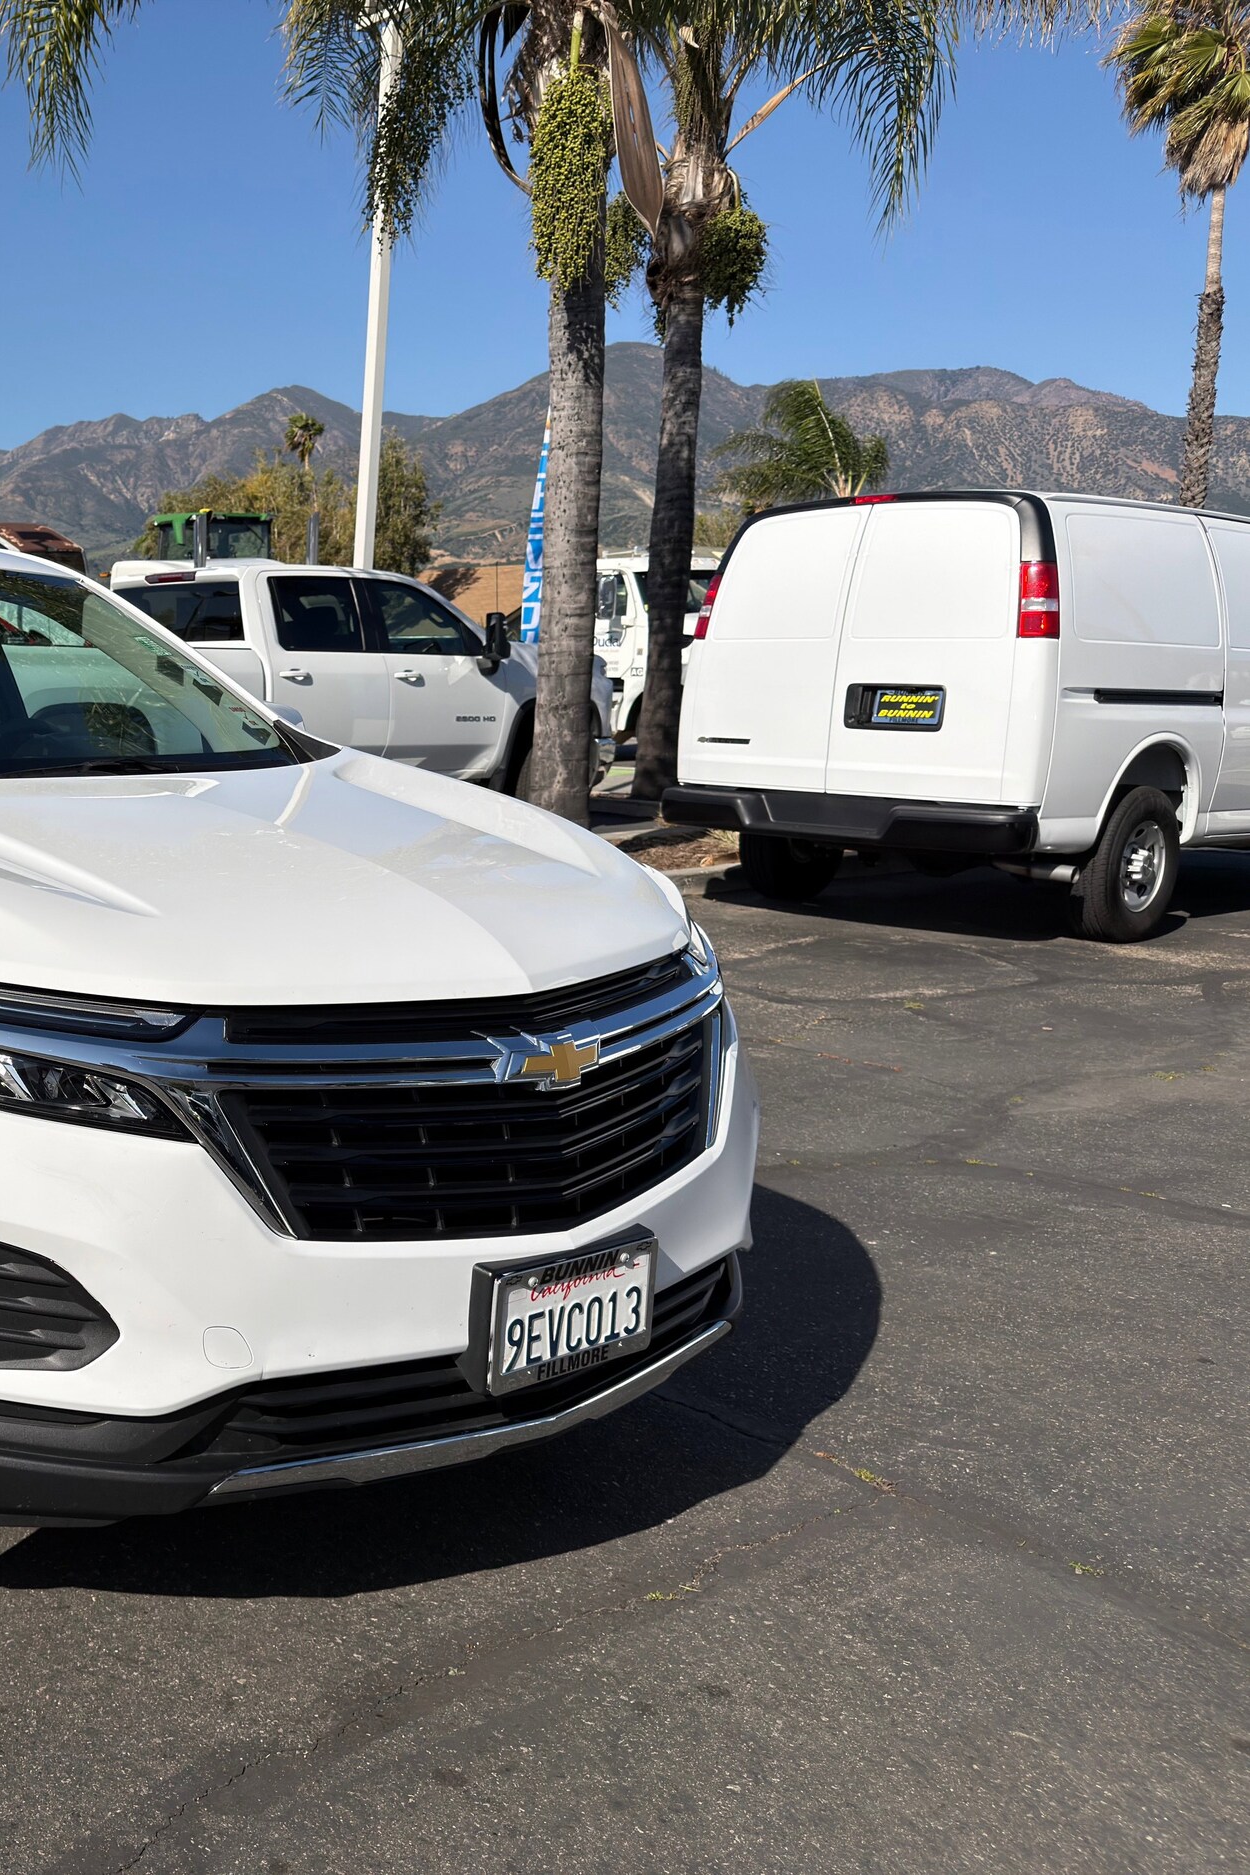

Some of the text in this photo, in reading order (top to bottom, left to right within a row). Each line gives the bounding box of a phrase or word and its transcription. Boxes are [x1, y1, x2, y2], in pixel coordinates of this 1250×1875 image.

[878, 710, 934, 718] BUNNIN
[881, 695, 939, 703] RUNNIN'
[530, 1265, 626, 1302] California
[539, 1249, 621, 1286] BUNNIN
[502, 1285, 642, 1374] 9EVC013
[536, 1344, 610, 1381] FILLMORE
